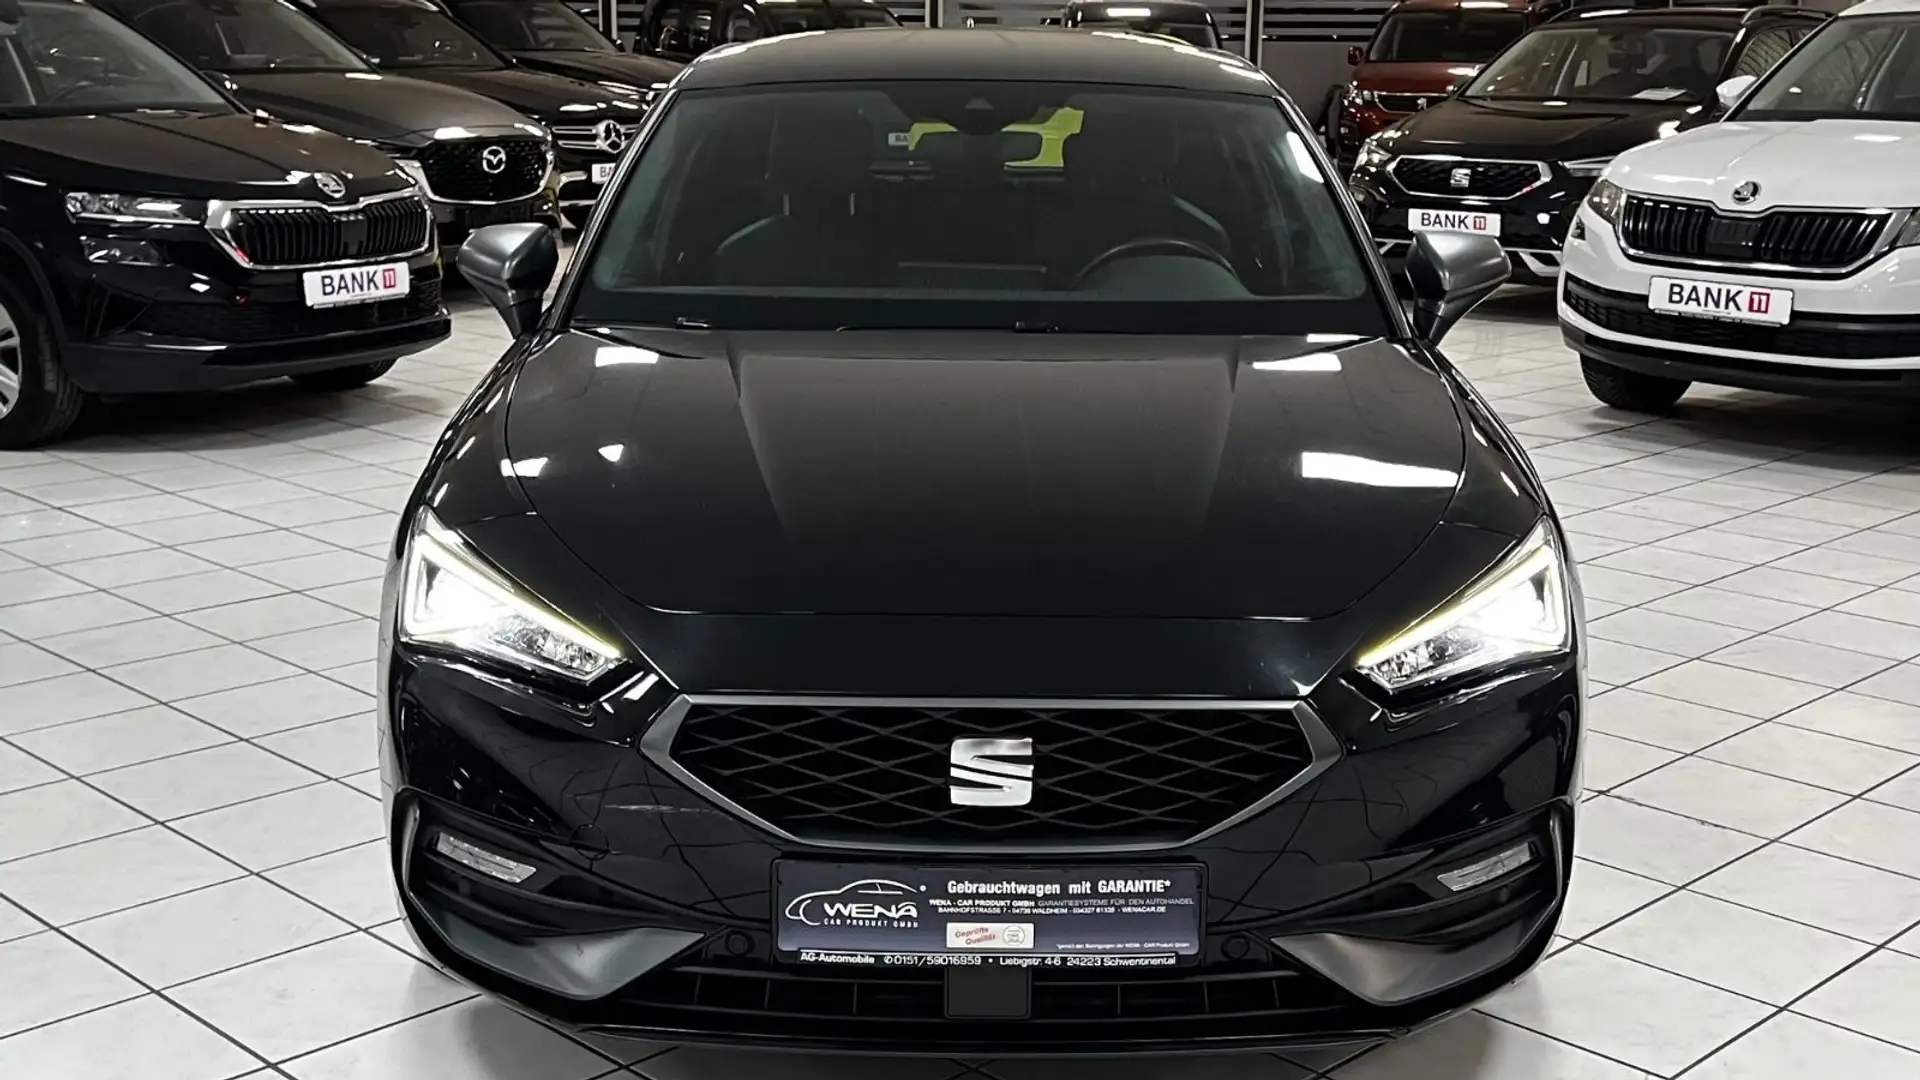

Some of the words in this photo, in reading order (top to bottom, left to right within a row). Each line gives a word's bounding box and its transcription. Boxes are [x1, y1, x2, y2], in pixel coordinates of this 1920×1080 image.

[1421, 212, 1469, 230] BANK
[1473, 216, 1486, 230] 11
[321, 270, 380, 296] BANK
[383, 268, 396, 289] 11
[1668, 283, 1743, 311] BANK
[1748, 292, 1770, 314] 11
[947, 881, 1060, 897] Gebrauchtwagen
[1069, 881, 1092, 894] mit
[823, 902, 917, 918] WENA
[846, 919, 888, 927] PRODUKT
[801, 953, 874, 964] AG-Automobile
[1067, 957, 1101, 966] 24223
